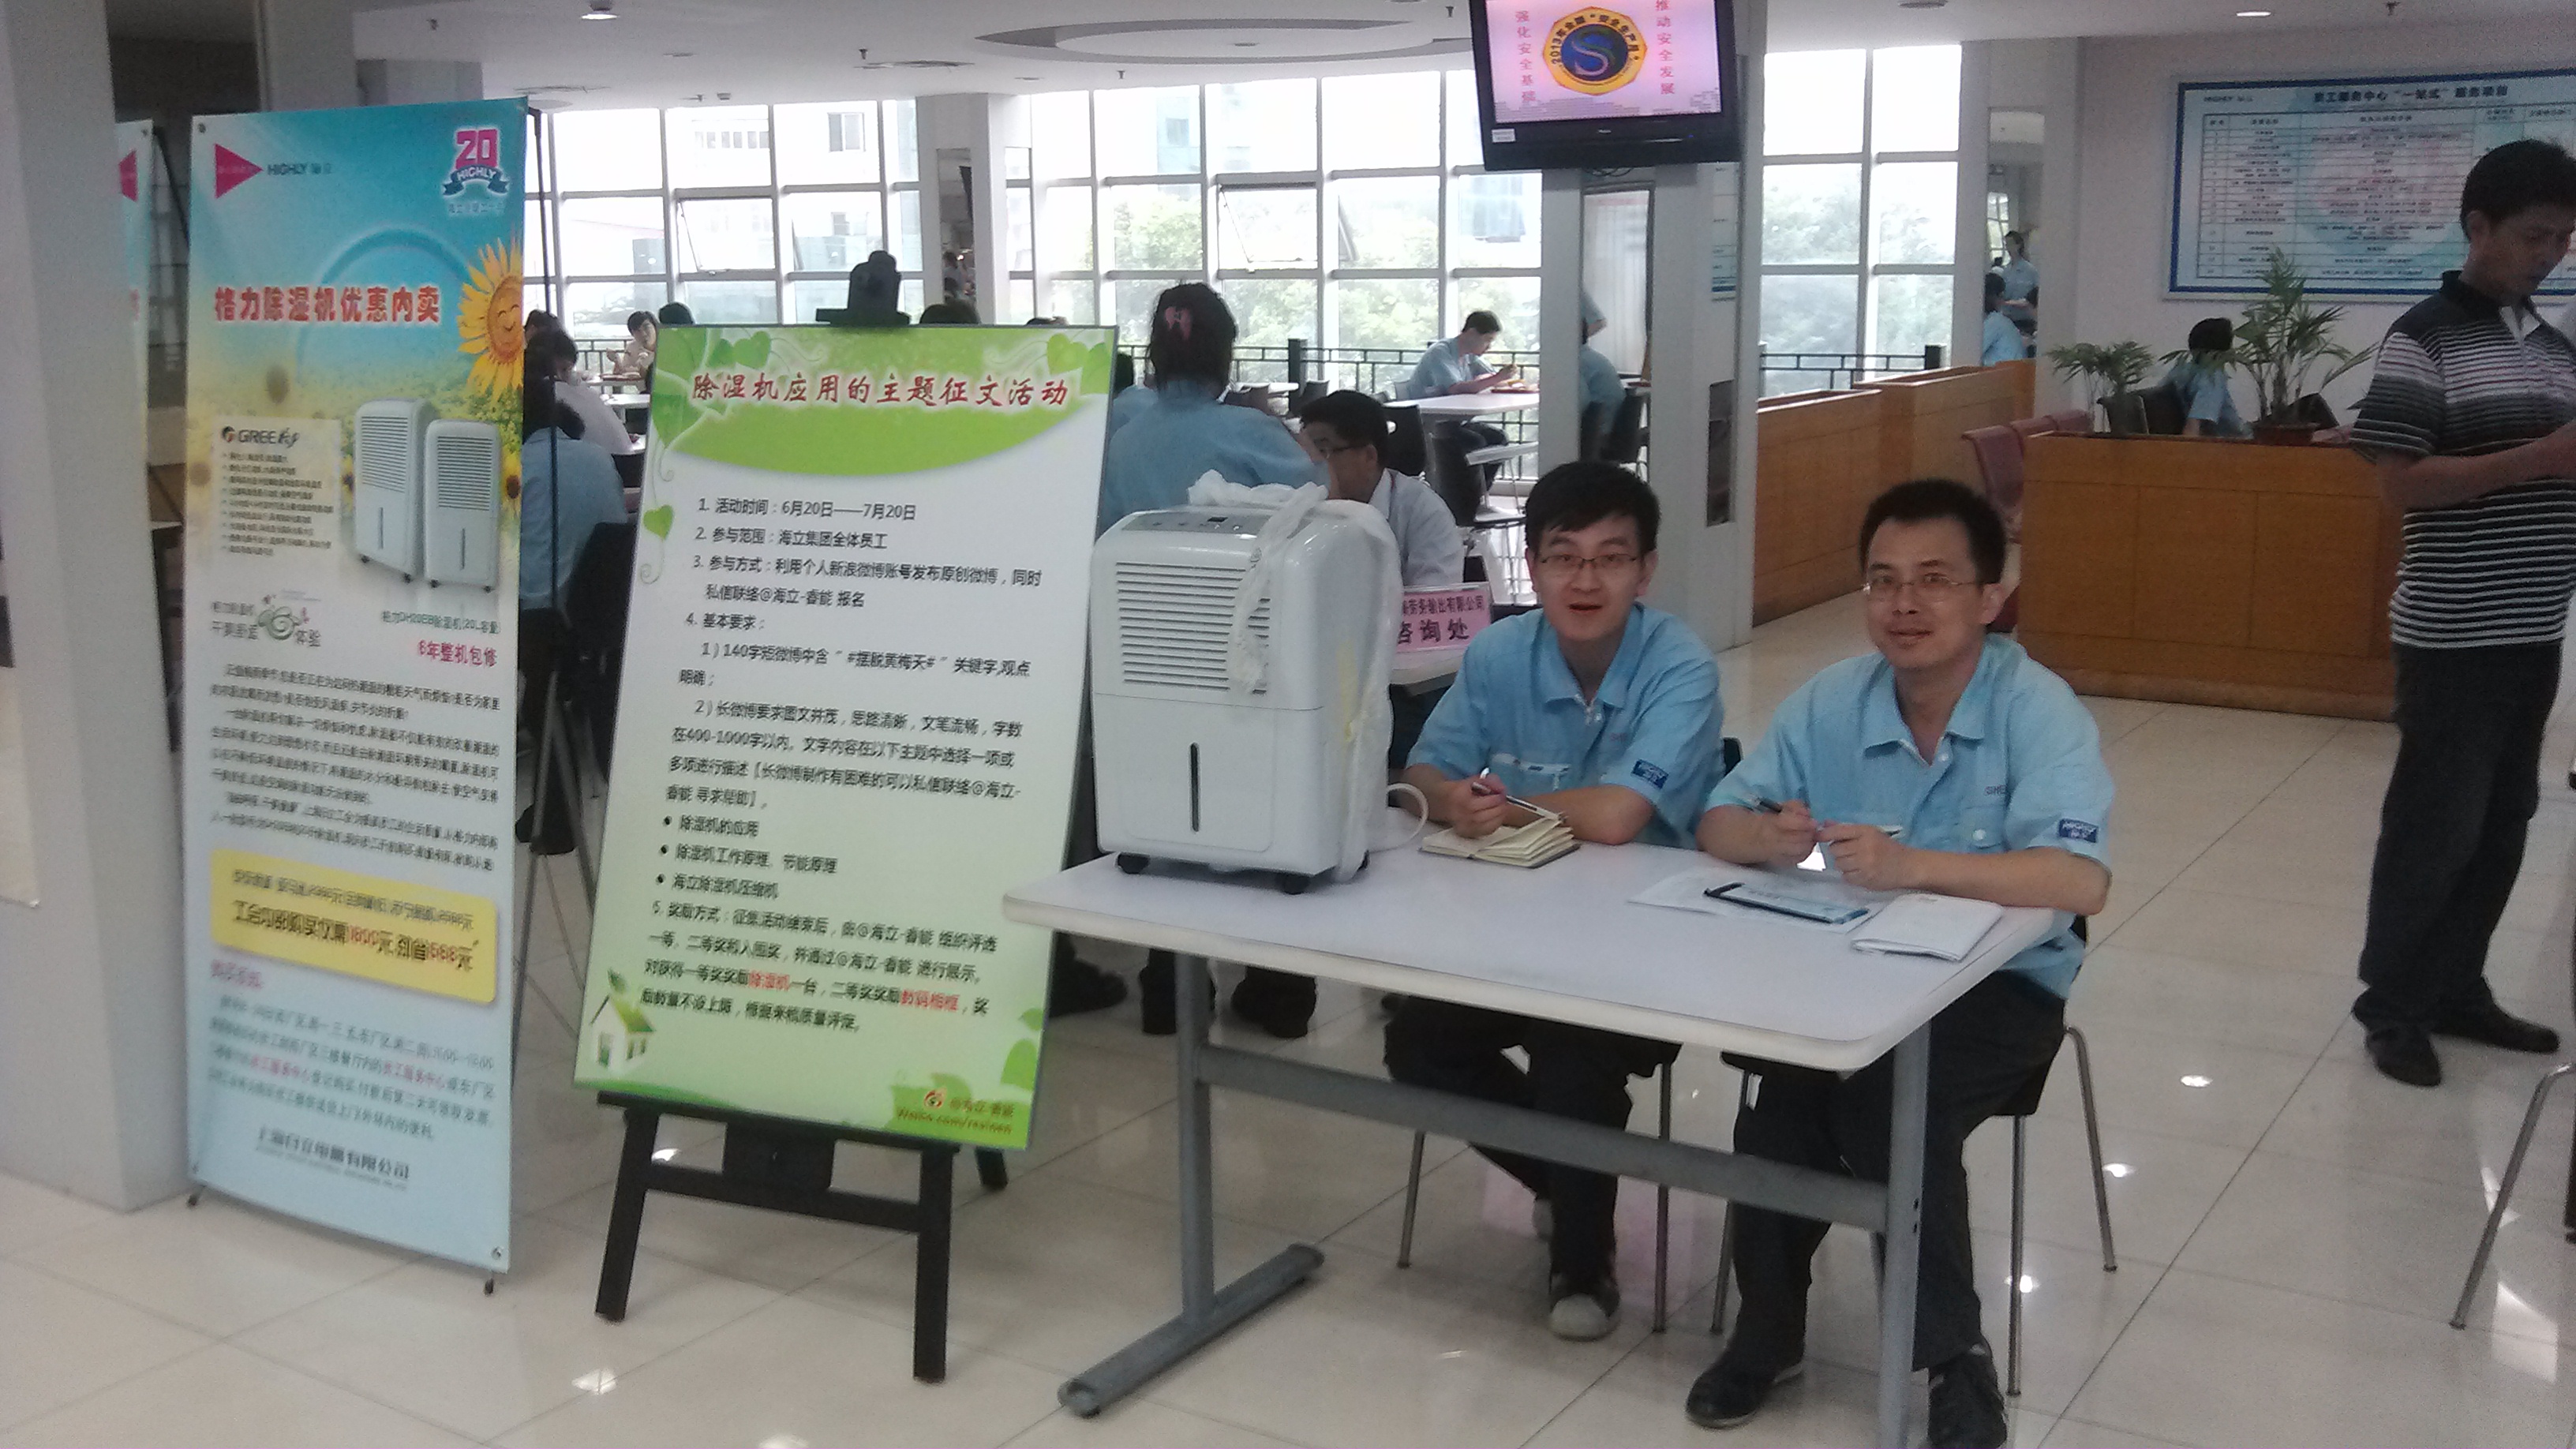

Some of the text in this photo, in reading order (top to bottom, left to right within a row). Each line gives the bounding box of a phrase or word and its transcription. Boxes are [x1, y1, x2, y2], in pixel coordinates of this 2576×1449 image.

[456, 129, 498, 169] 20
[268, 163, 308, 175] HIGHLY
[457, 167, 496, 181] HIGHLY
[214, 285, 441, 324] 格力除湿机优惠内卖
[691, 370, 1069, 408] 除湿机应用的主题征文活动
[238, 429, 277, 444] GREE
